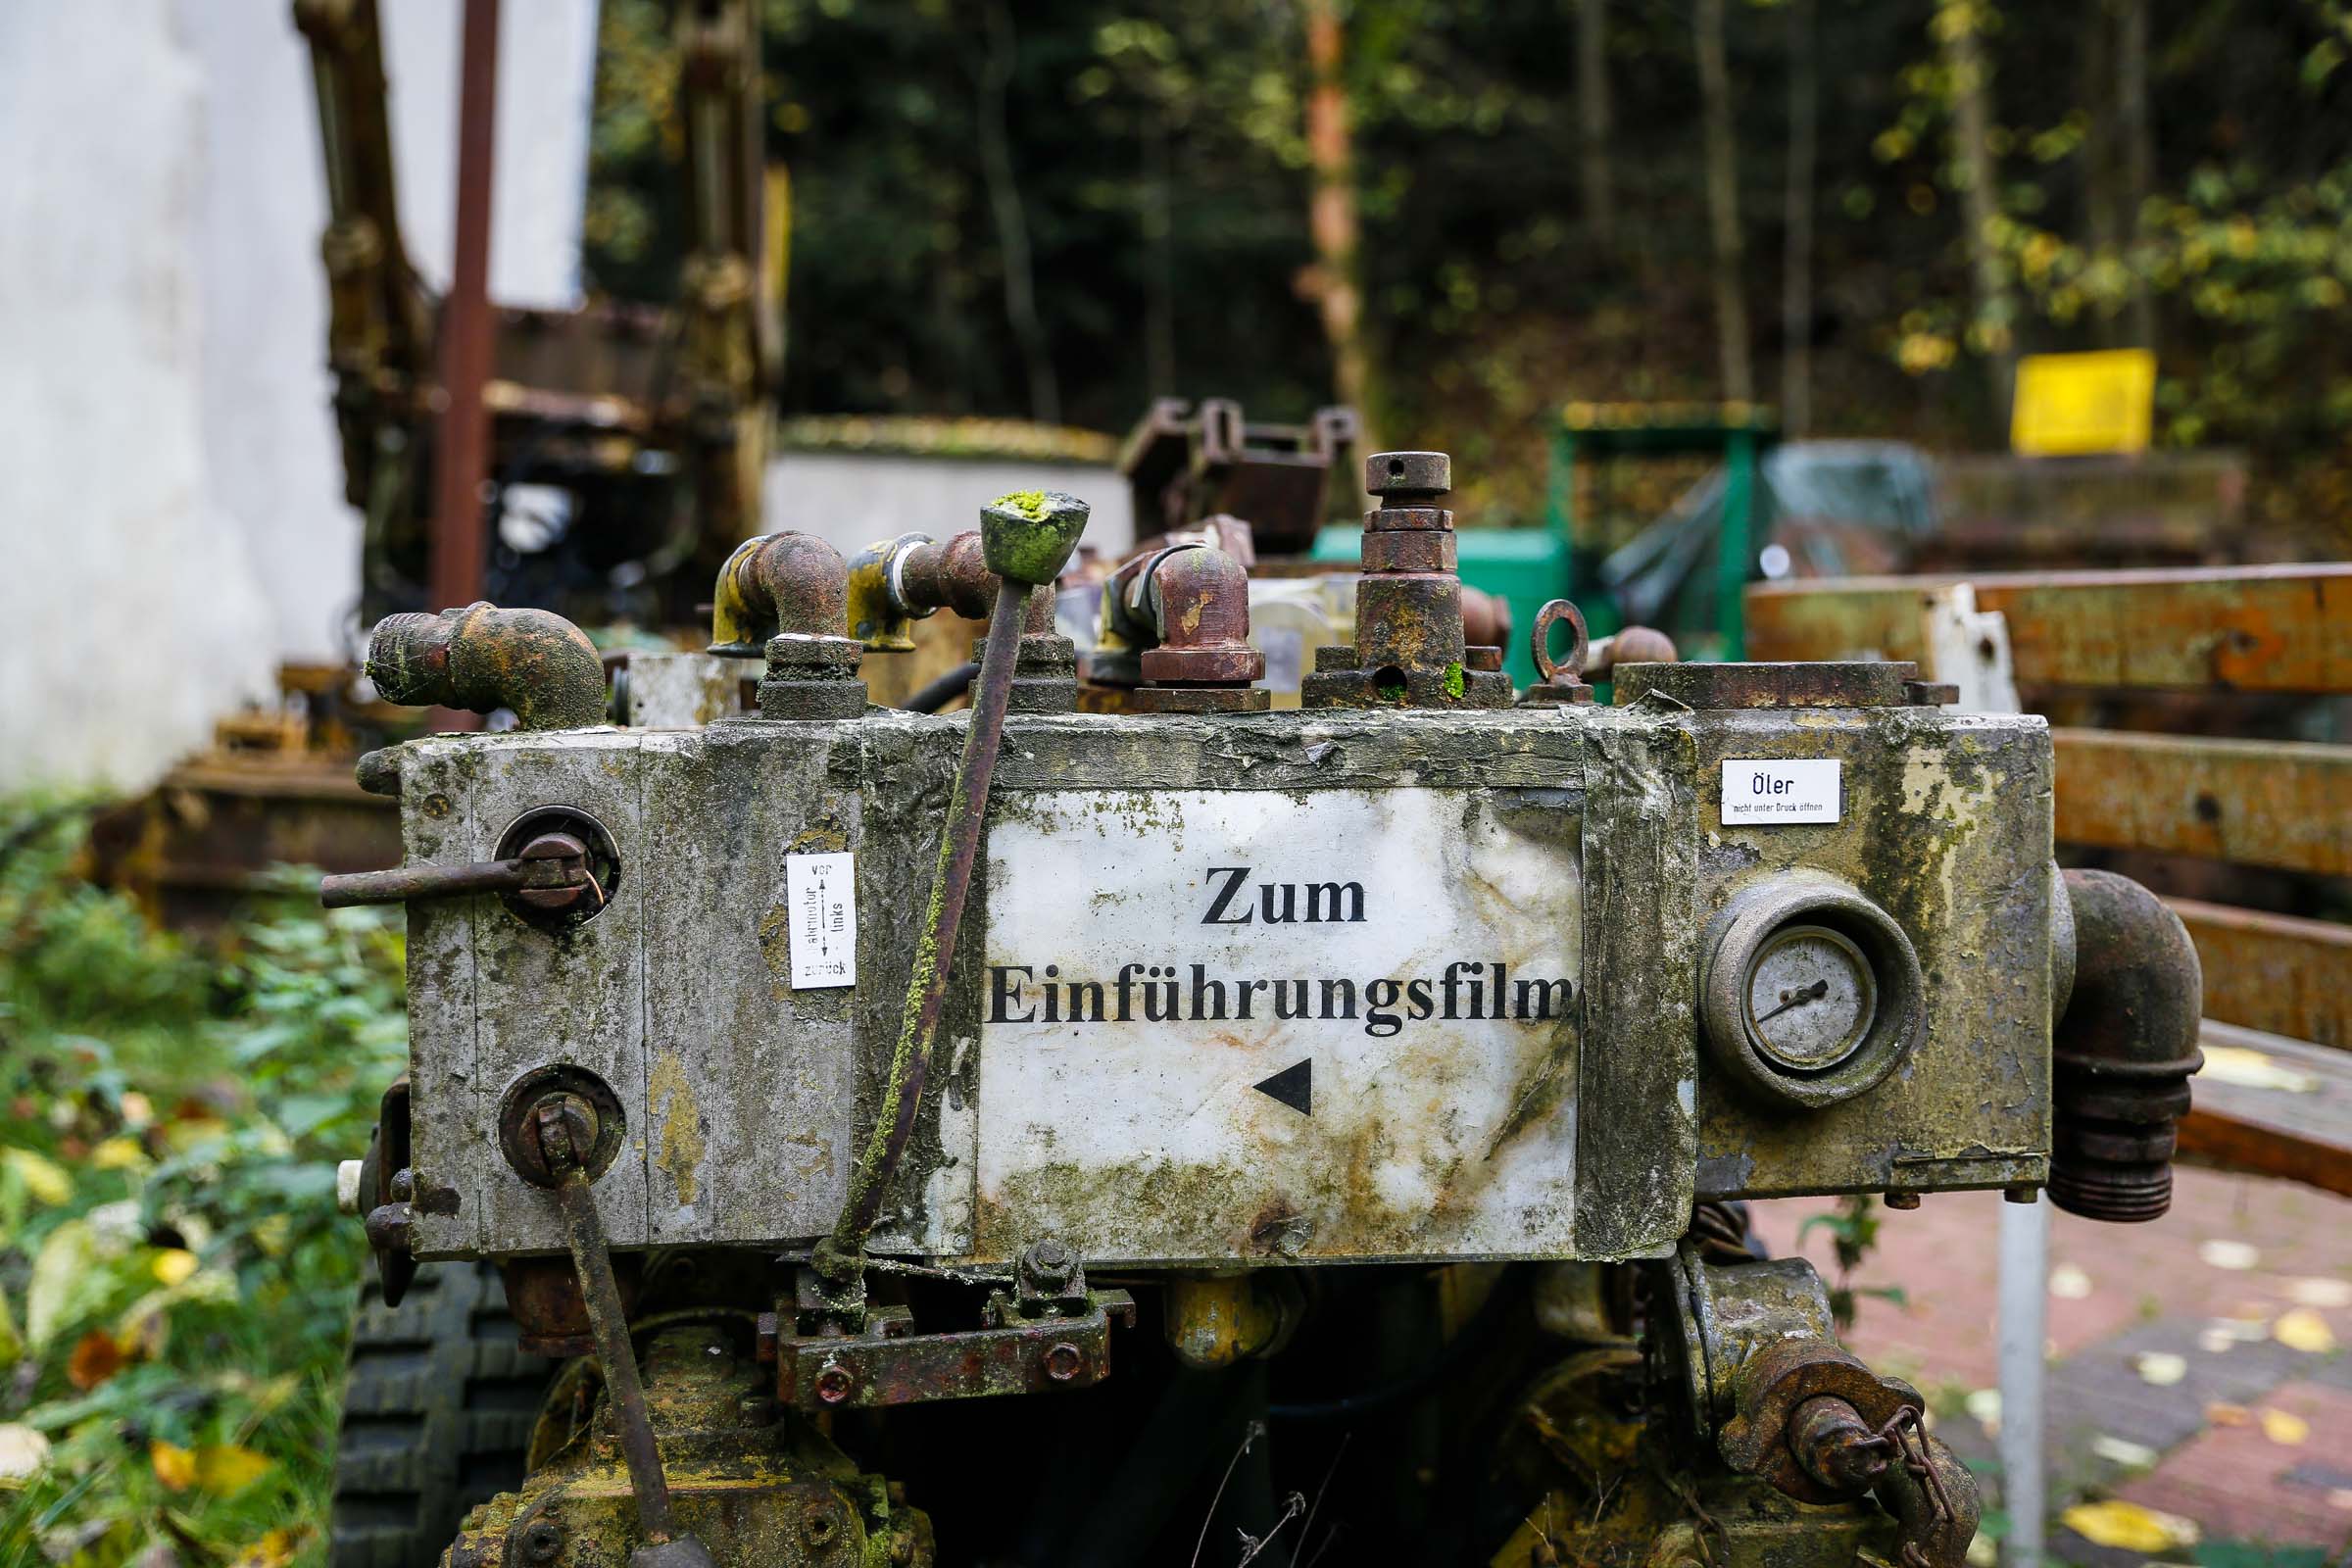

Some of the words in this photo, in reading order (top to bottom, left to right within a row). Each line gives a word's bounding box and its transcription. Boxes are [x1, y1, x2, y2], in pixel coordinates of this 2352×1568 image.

[1752, 772, 1794, 795] Öler
[1734, 803, 1751, 812] nicht
[1754, 804, 1775, 812] unter
[1776, 803, 1796, 811] Druck
[1799, 802, 1823, 811] öffnen
[1200, 866, 1368, 925] Zum
[830, 903, 844, 932] links
[984, 961, 1574, 1038] Einführungsfilm
